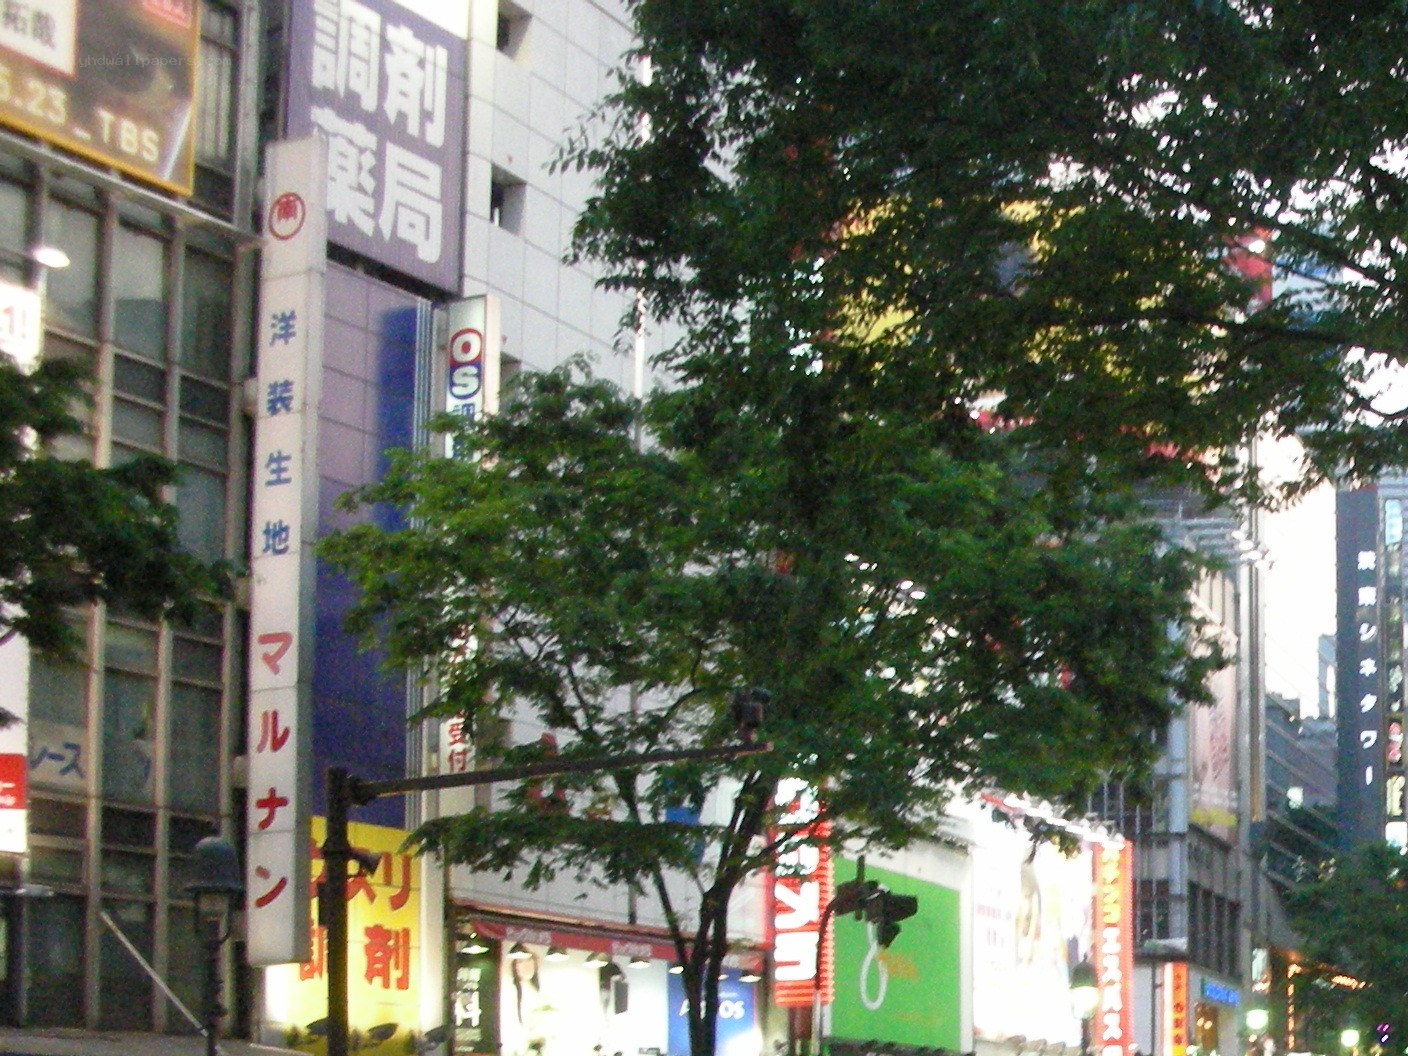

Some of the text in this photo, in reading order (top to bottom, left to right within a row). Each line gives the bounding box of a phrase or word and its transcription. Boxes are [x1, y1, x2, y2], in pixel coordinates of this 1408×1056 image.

[97, 107, 160, 163] TBS
[311, 0, 449, 149] 調剤
[310, 106, 443, 264] 薬局
[261, 311, 298, 556] 洋装生地
[253, 632, 294, 909] マルナン
